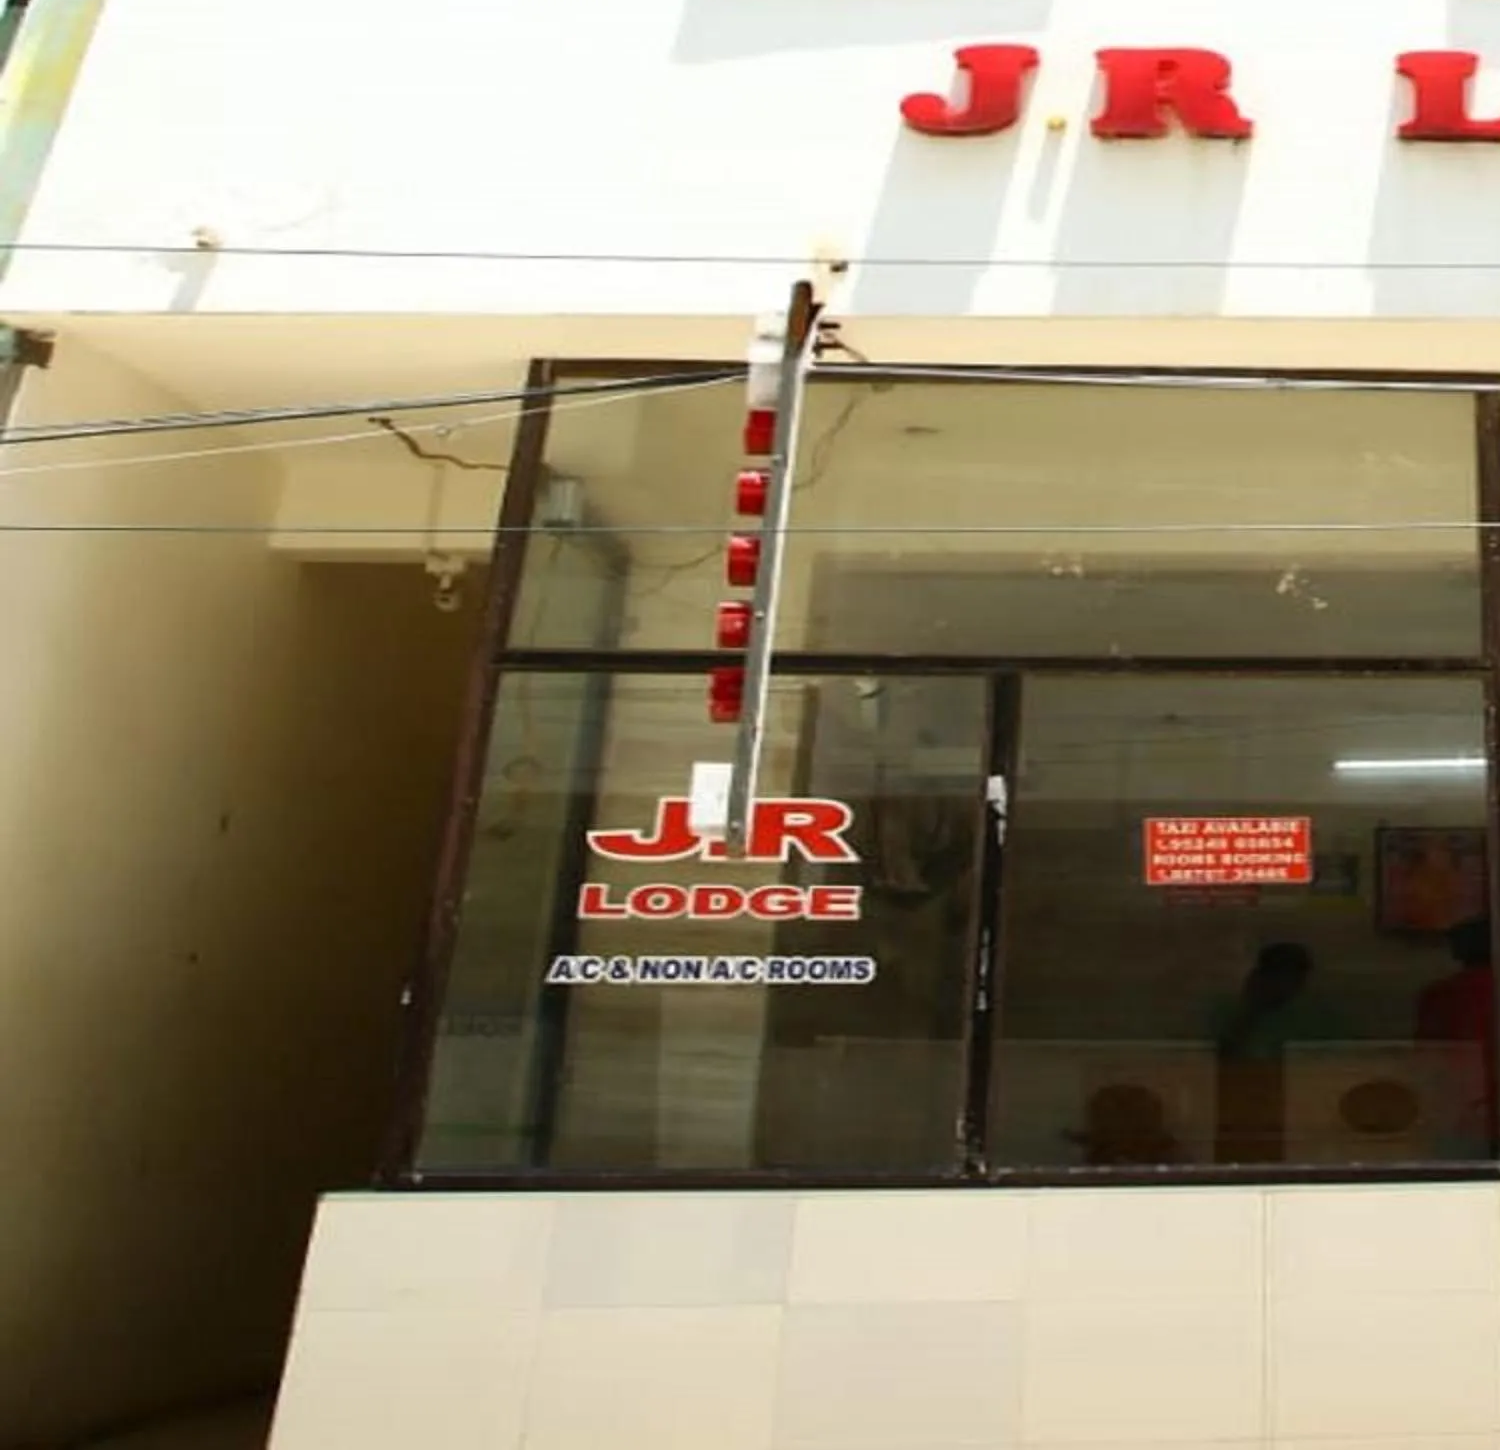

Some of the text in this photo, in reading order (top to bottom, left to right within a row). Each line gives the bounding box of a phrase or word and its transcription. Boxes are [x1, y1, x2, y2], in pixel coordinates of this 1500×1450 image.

[1156, 821, 1198, 835] TAXI
[1152, 853, 1217, 866] ROOMS
[577, 884, 863, 921] LODGE
[608, 955, 631, 983] &
[637, 955, 706, 983] NON
[764, 955, 875, 983] ROOMS
